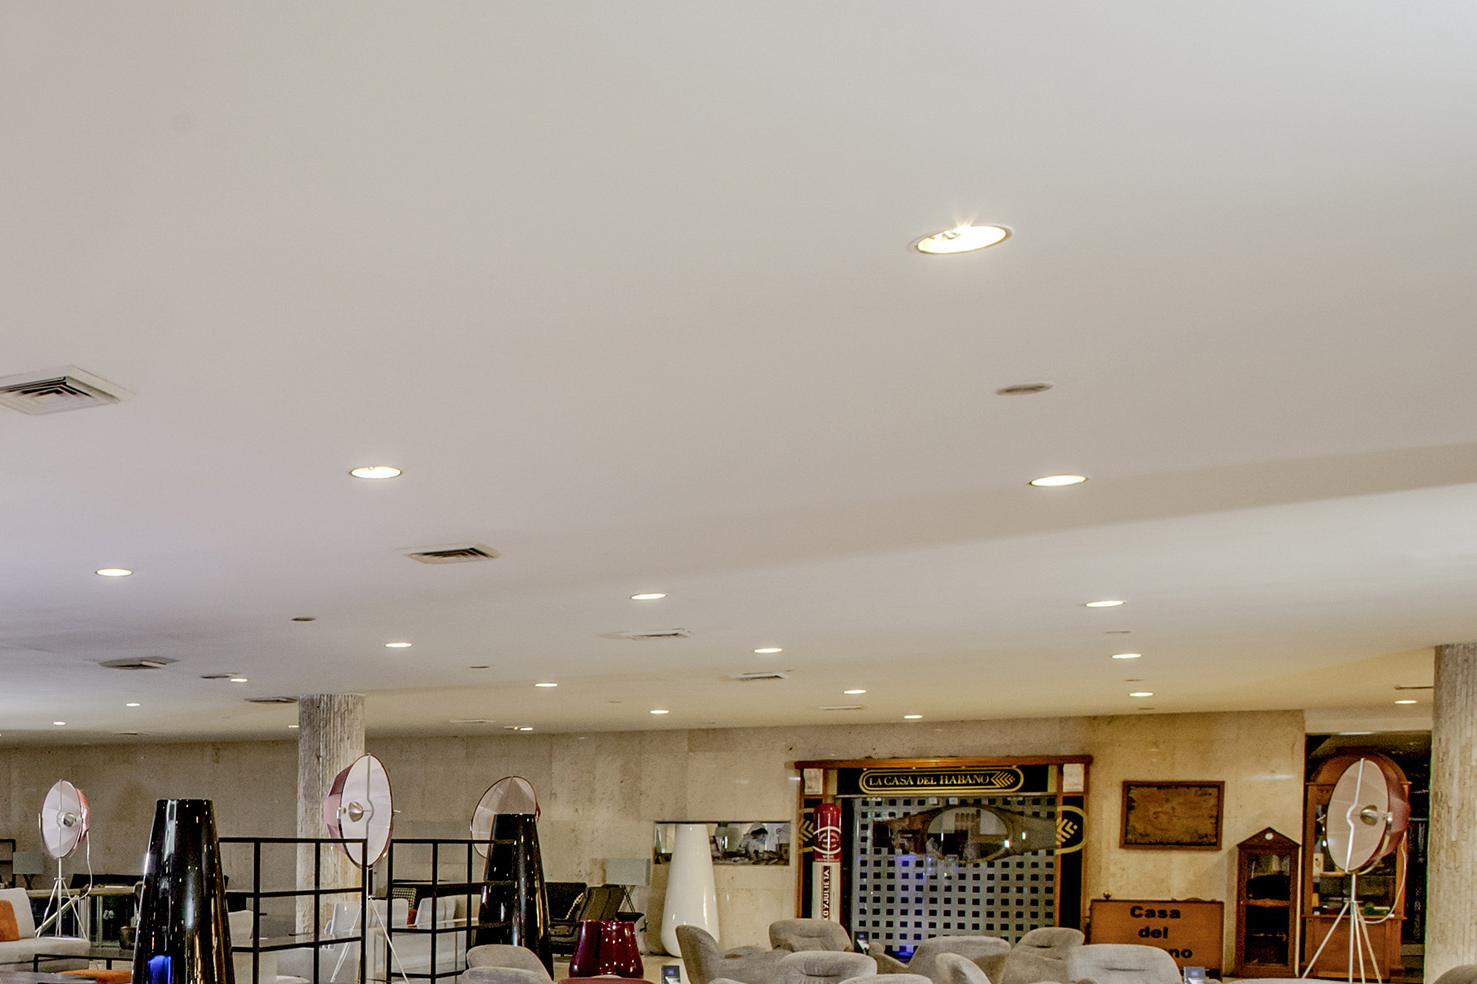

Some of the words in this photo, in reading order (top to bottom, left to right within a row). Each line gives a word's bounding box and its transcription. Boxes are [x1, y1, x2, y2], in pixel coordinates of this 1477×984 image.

[869, 777, 882, 786] LA
[884, 775, 914, 786] CASA
[917, 776, 937, 785] DEL
[939, 774, 990, 785] HABANO
[1129, 905, 1182, 919] Casa
[1138, 926, 1169, 939] del
[1165, 948, 1193, 959] no
